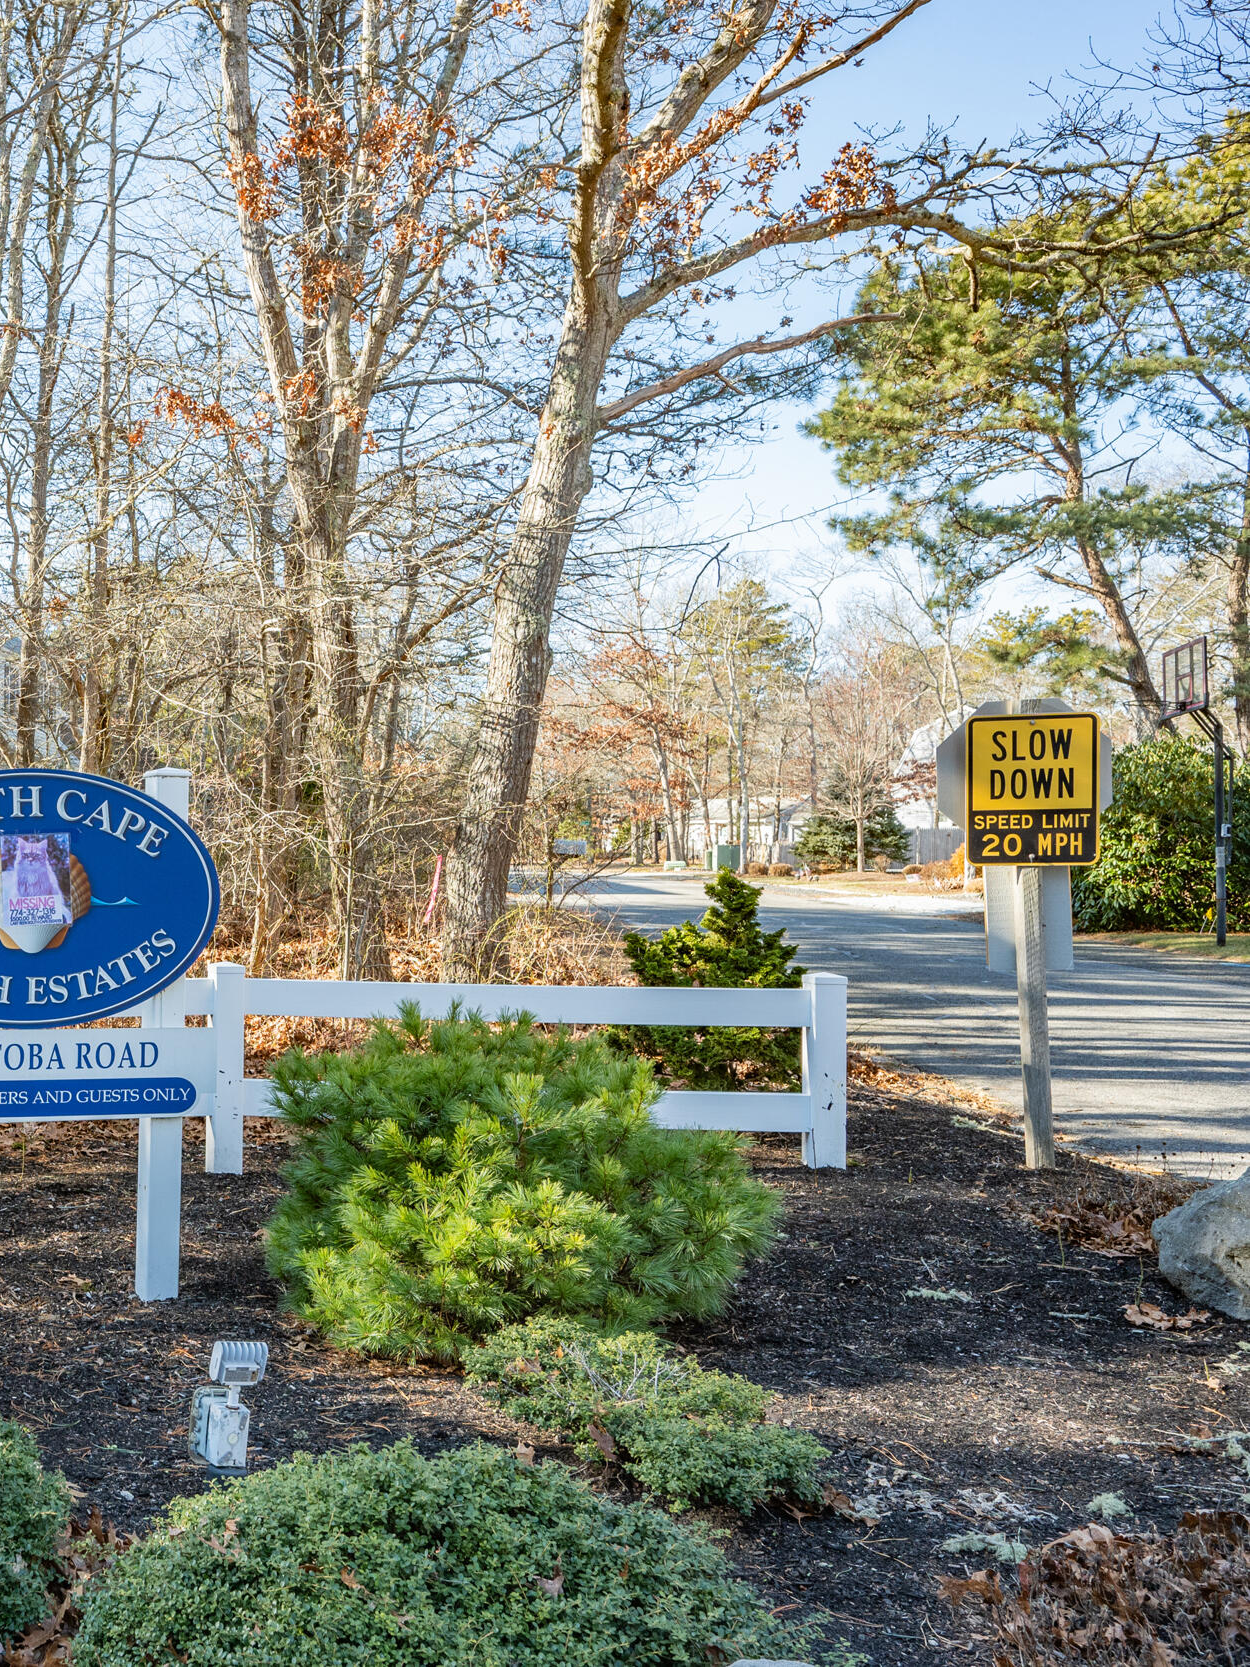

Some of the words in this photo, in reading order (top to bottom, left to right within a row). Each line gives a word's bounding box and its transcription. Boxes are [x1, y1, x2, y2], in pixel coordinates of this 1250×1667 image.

[991, 728, 1073, 761] SLOW
[990, 767, 1074, 799] DOWN
[56, 789, 170, 858] CAPE
[973, 814, 1033, 830] SPEED
[1042, 813, 1091, 829] LIMIT
[981, 833, 1022, 857] 20
[1037, 832, 1083, 856] MPH
[9, 896, 55, 910] MISSING
[25, 928, 176, 1005] ESTATES
[75, 1041, 159, 1070] ROAD
[32, 1089, 72, 1104] AND
[76, 1088, 139, 1103] GUESTS
[143, 1087, 191, 1102] ONLY
